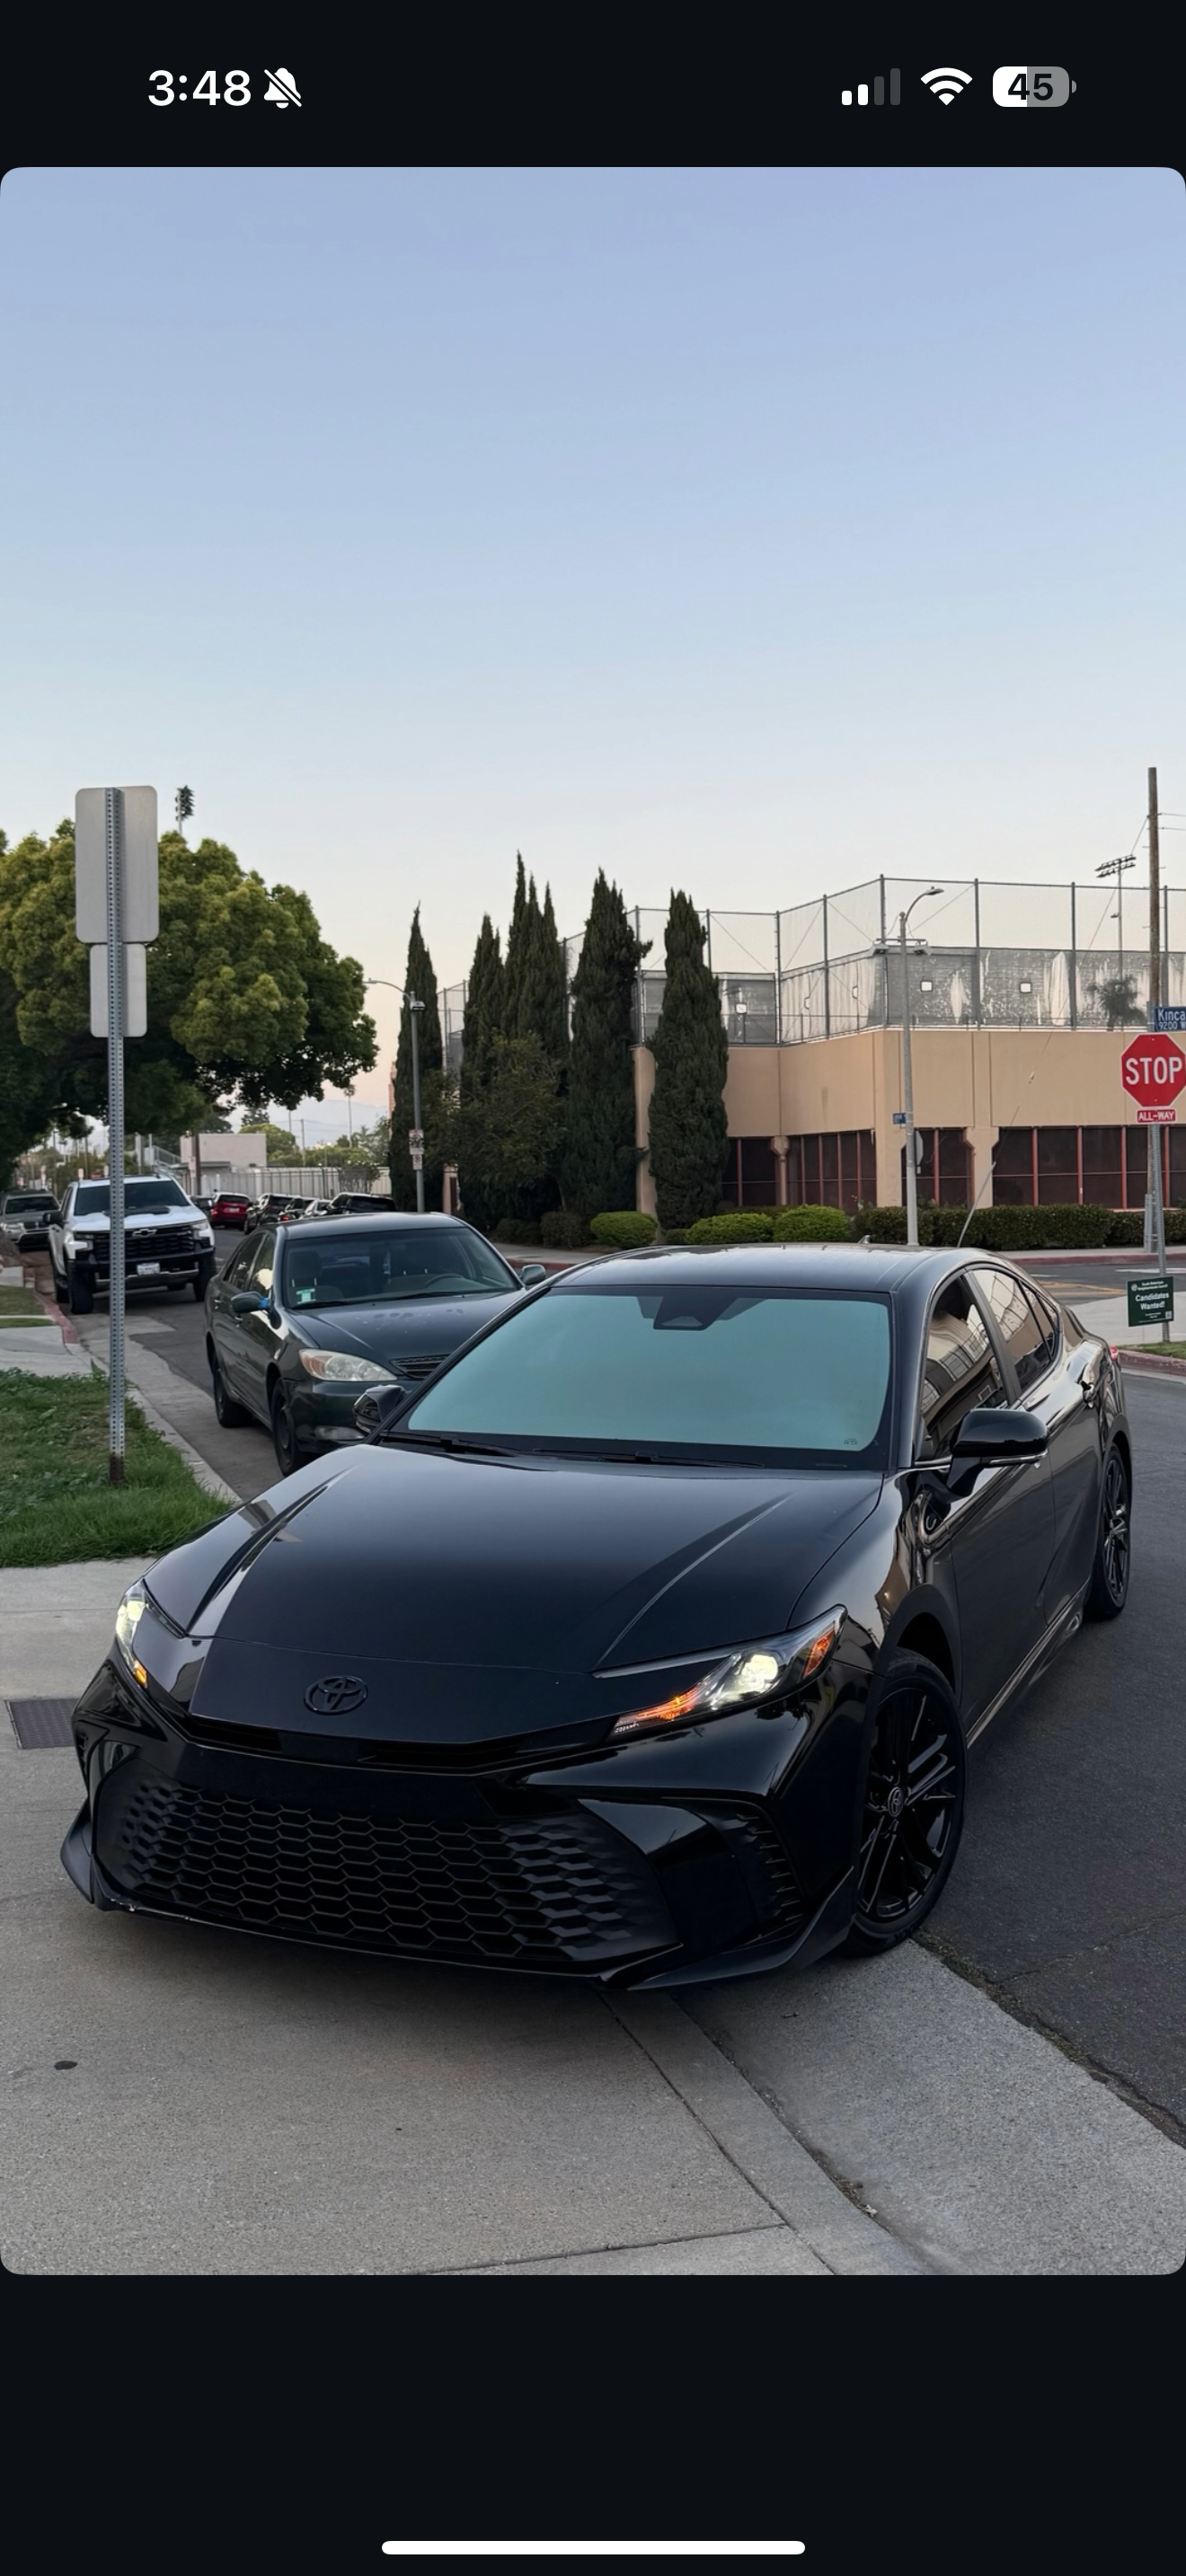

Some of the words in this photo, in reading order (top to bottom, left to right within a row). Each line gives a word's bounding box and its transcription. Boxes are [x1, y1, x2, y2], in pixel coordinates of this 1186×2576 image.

[1159, 1021, 1178, 1030] 9200
[1126, 1056, 1182, 1085] STOP
[1138, 1111, 1174, 1121] ALL-WAY
[1136, 1292, 1169, 1301] Candidates
